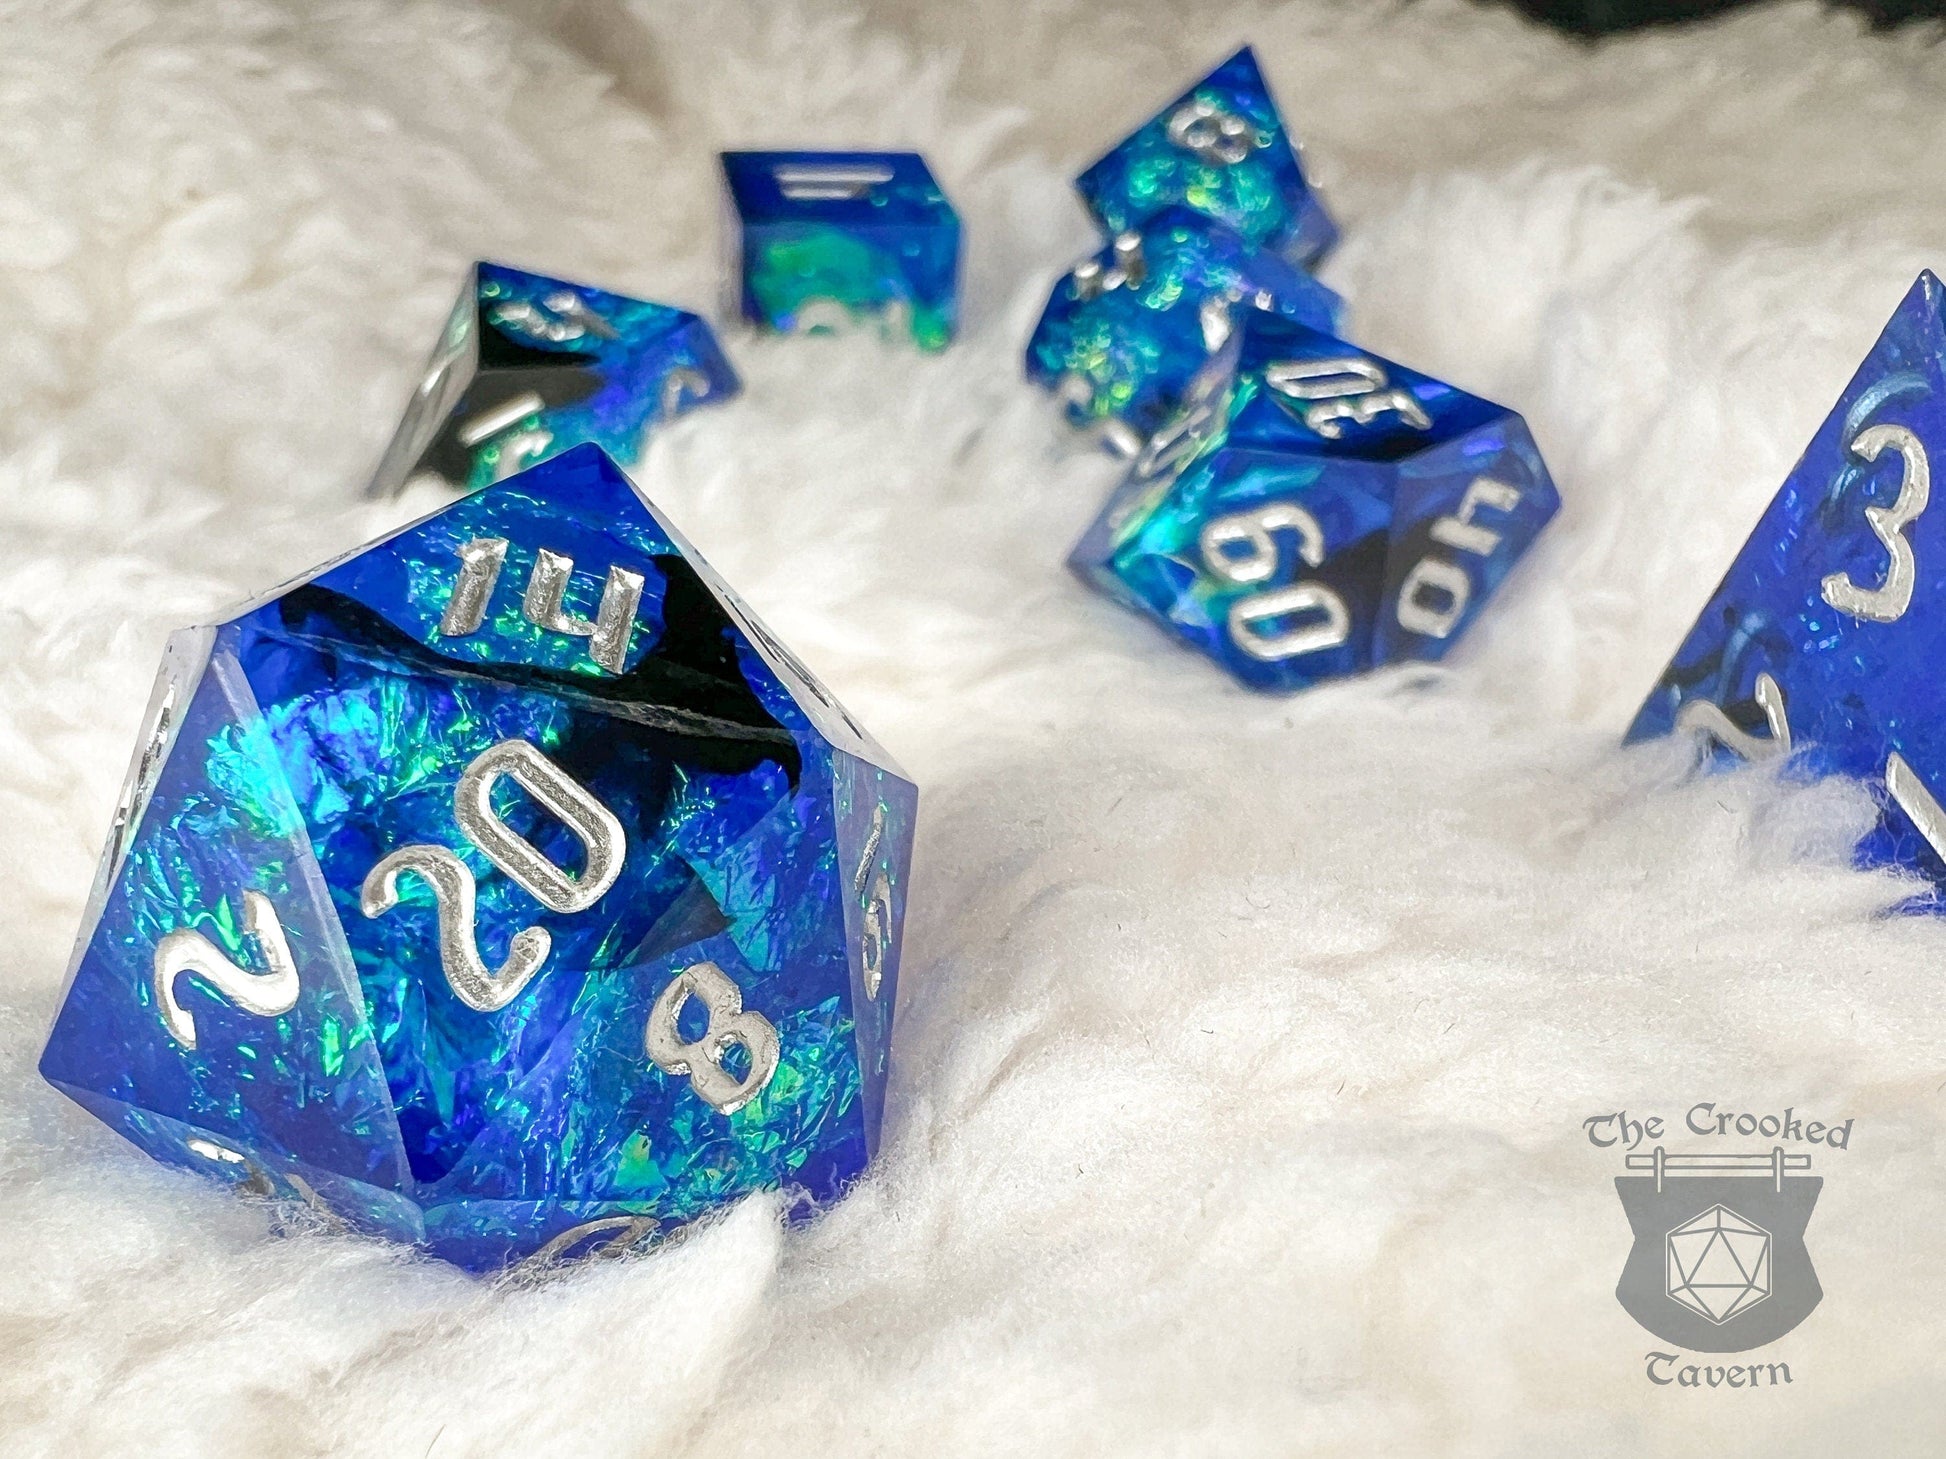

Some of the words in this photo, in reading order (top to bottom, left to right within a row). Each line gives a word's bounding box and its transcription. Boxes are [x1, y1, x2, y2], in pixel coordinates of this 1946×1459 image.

[1820, 424, 1931, 623] 3
[442, 536, 645, 675] 14
[360, 739, 628, 1012] 20
[153, 890, 300, 1051] 2
[643, 962, 781, 1115] 8
